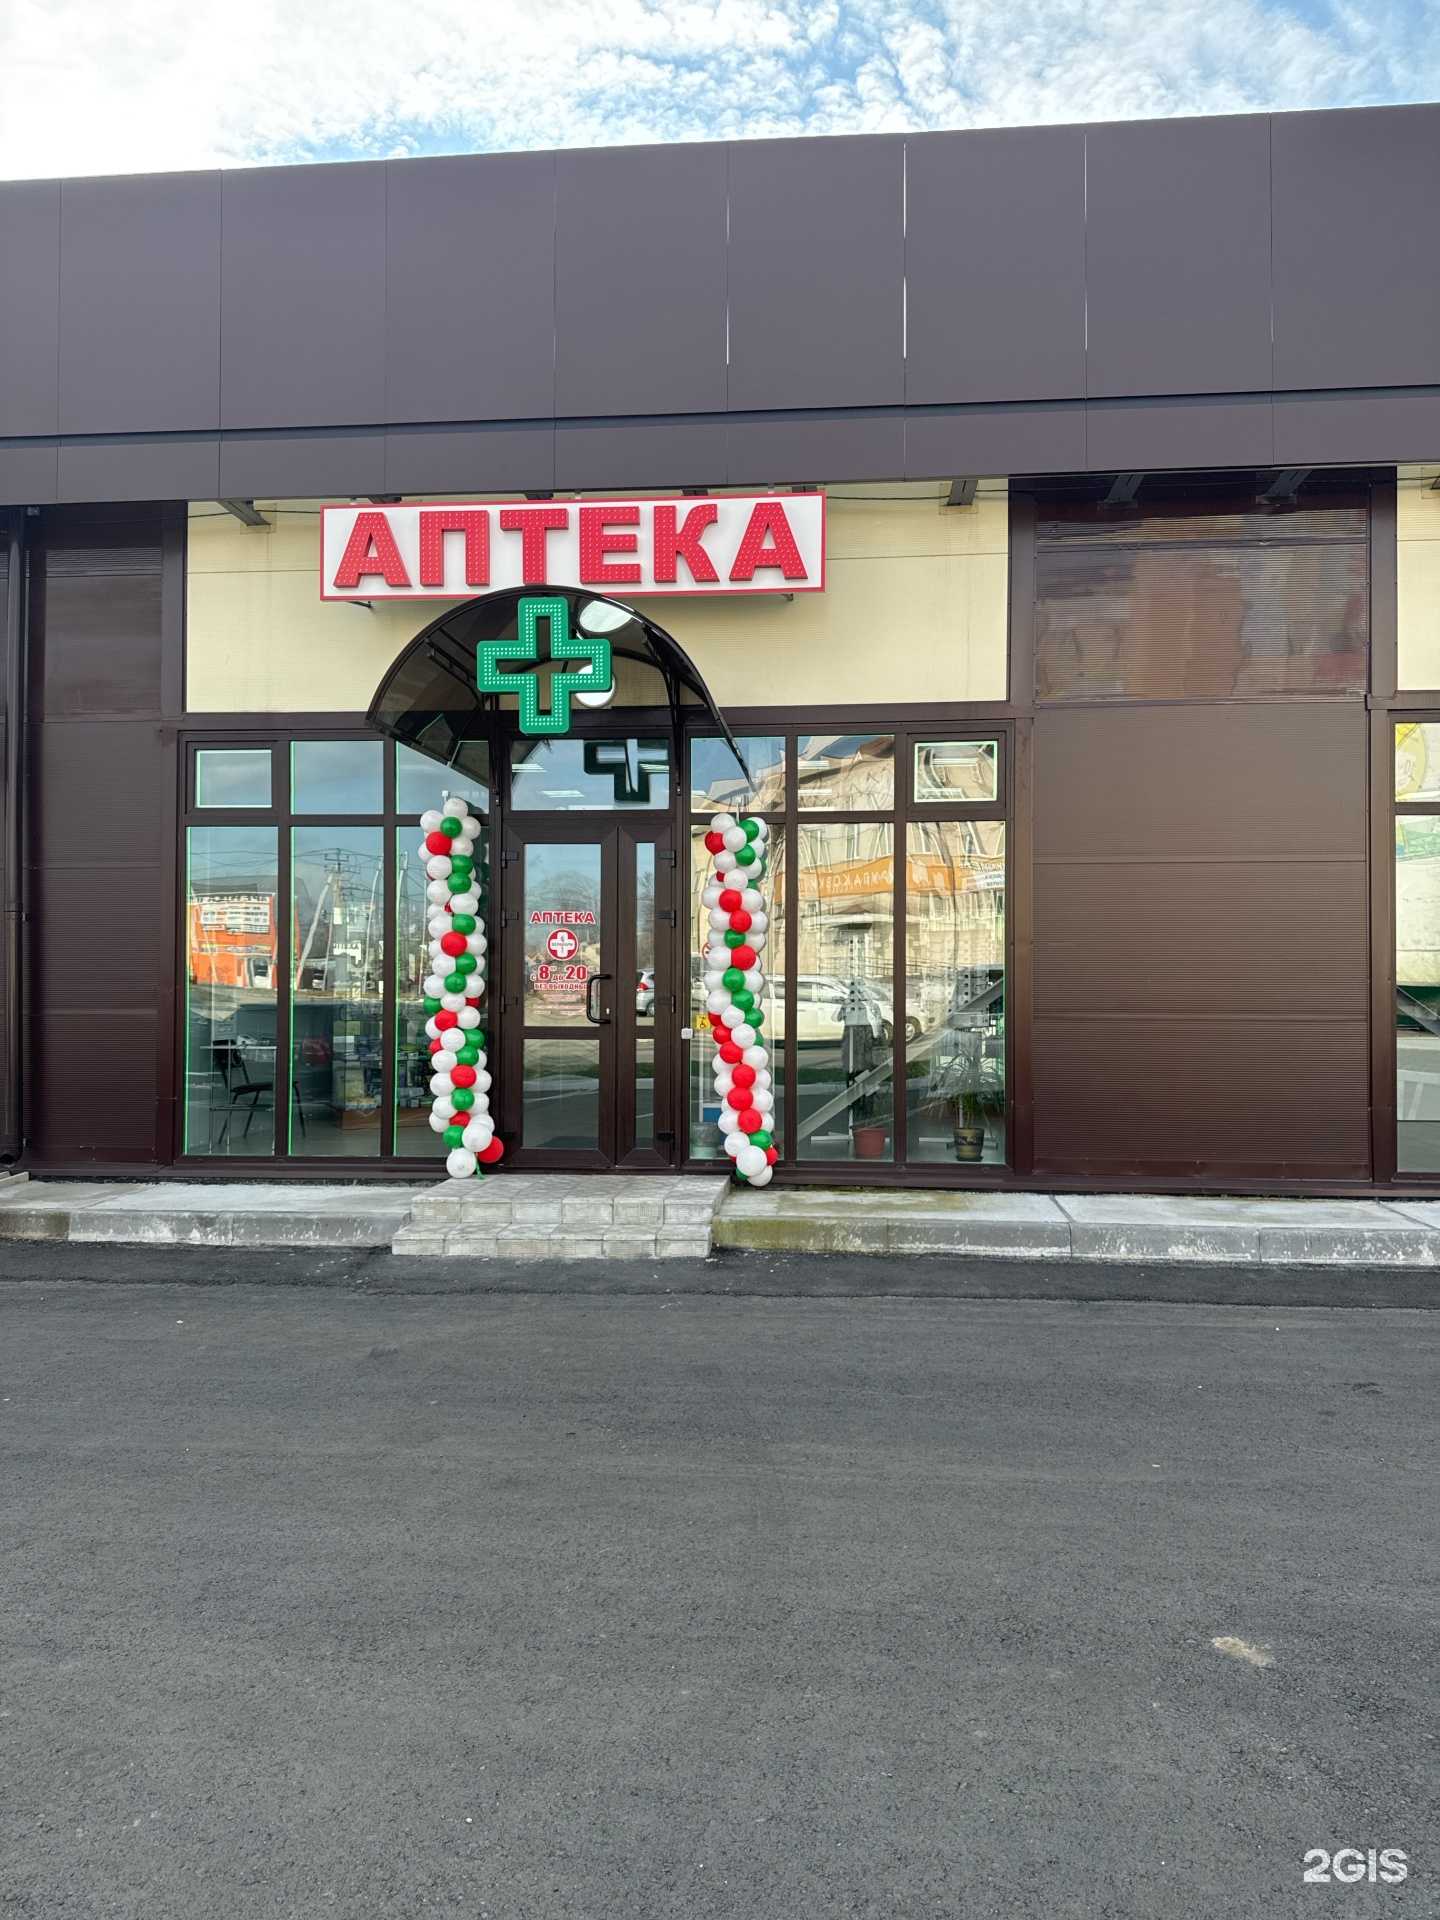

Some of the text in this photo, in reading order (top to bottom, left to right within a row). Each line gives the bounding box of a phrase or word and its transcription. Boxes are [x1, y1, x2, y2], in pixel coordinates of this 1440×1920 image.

[333, 502, 808, 588] АПТЕКА
[530, 911, 595, 924] АПТЕКА
[550, 982, 588, 991] ВЫХОДНЫ
